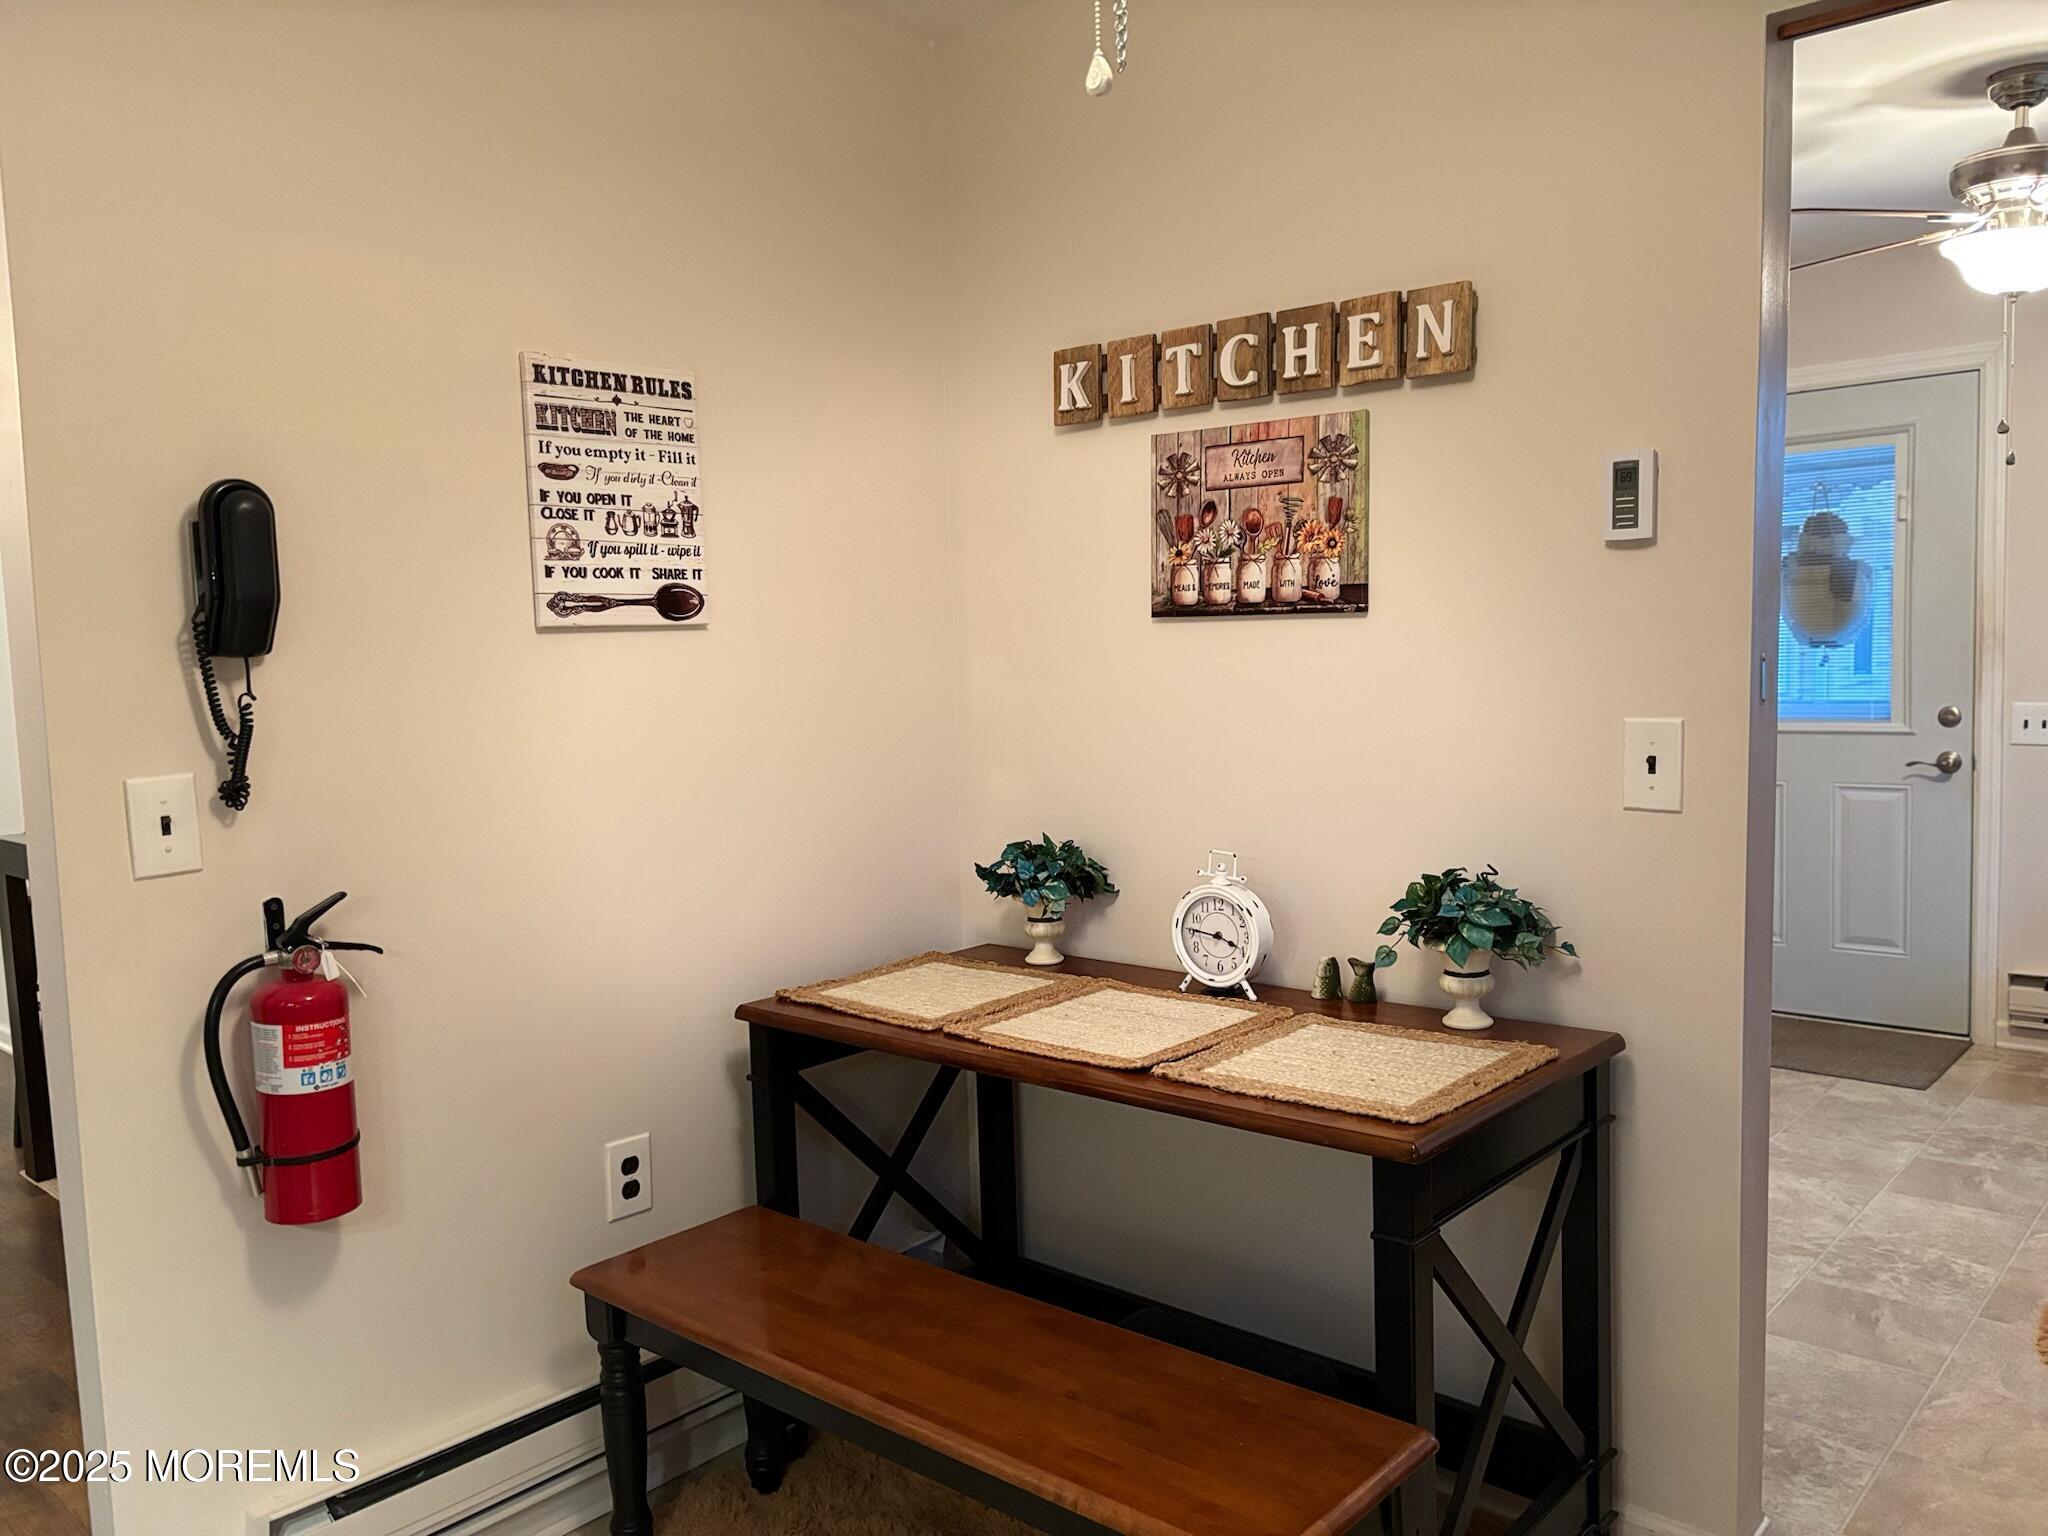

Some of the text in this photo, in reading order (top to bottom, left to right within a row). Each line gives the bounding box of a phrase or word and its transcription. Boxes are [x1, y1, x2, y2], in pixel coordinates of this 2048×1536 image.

[1058, 299, 1457, 412] KITCHEN
[532, 363, 692, 400] KITCHEN RULES
[535, 403, 617, 436] KITCHEN
[624, 411, 680, 427] THE HEART
[625, 428, 695, 443] OF THE HOME
[539, 440, 552, 454] If
[555, 445, 581, 459] you
[585, 448, 631, 463] empty
[635, 449, 646, 461] it
[659, 450, 683, 463] Fill
[686, 452, 696, 465] it
[1232, 448, 1277, 469] Kitchen
[585, 466, 600, 484] If
[604, 473, 621, 486] you
[1224, 468, 1284, 482] ALWAYS OPEN
[540, 489, 632, 506] IF YOU OPEN IT
[541, 507, 595, 521] CLOSE IT
[600, 542, 621, 558] you
[624, 542, 648, 557] spill
[650, 543, 659, 556] it
[667, 543, 690, 559] wipe
[692, 545, 701, 557] it
[545, 565, 702, 580] IF YOU COOK IT SHARE IT
[1244, 580, 1260, 589] MADE
[1280, 579, 1295, 588] WITH
[1201, 902, 1209, 912] 11
[1212, 899, 1224, 911] 12
[1192, 913, 1201, 924] 10
[1194, 941, 1200, 953] 8
[1203, 955, 1209, 967] 7
[1218, 960, 1224, 972] 6
[1231, 958, 1237, 970] 5
